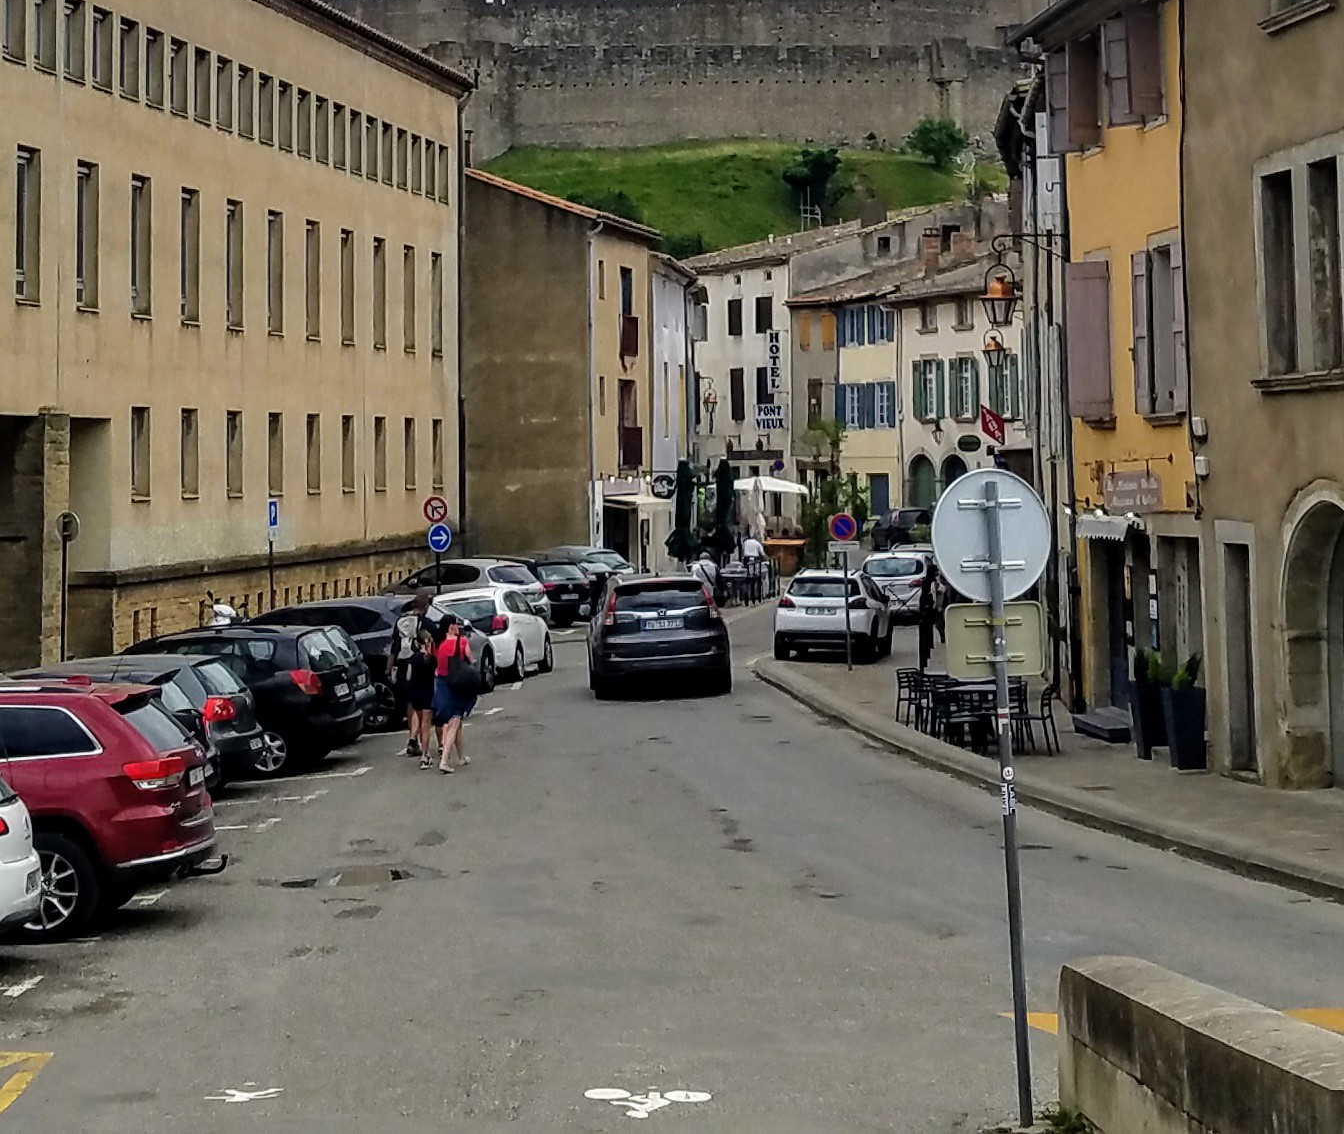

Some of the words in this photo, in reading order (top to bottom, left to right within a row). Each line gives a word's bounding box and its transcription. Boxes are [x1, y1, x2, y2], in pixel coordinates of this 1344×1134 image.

[769, 332, 780, 389] HOTEL
[757, 406, 782, 417] PONT
[756, 418, 785, 430] VIEUX
